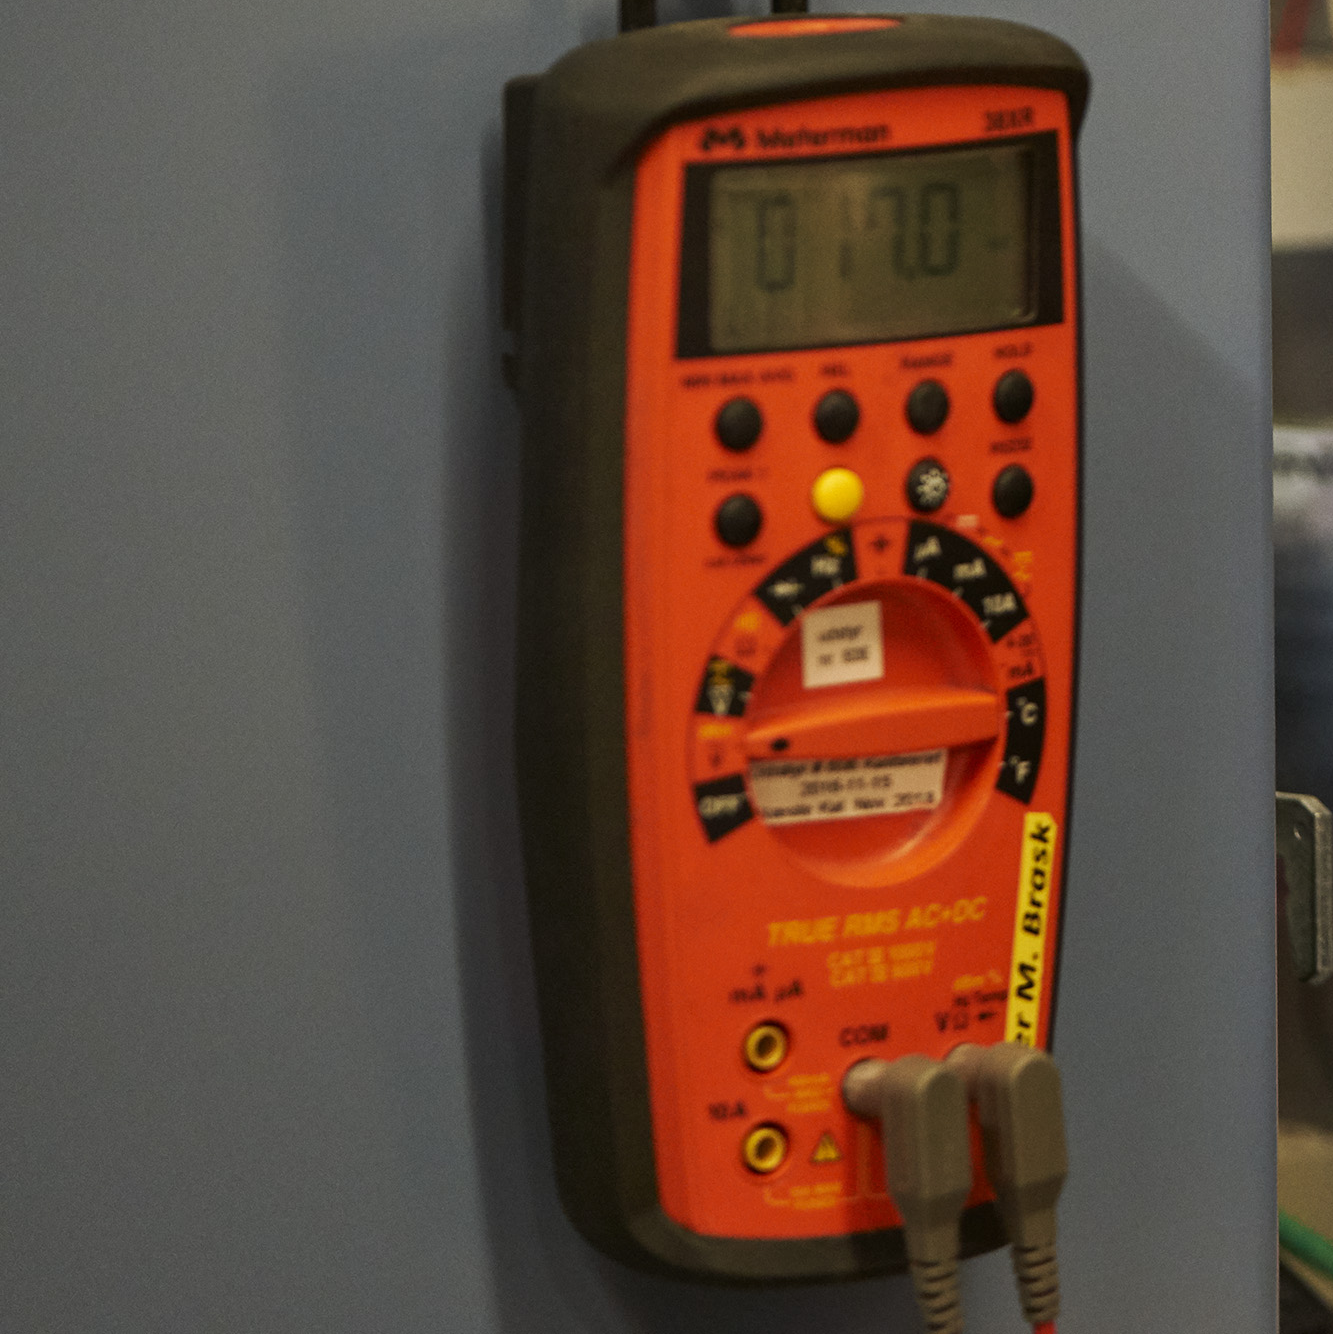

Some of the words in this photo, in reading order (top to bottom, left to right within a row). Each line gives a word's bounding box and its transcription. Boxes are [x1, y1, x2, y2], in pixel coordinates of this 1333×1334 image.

[1022, 821, 1051, 937] Brask
[768, 917, 838, 947] TRUE
[842, 908, 901, 938] RMS
[1015, 951, 1039, 1002] M.
[840, 1023, 890, 1047] COM
